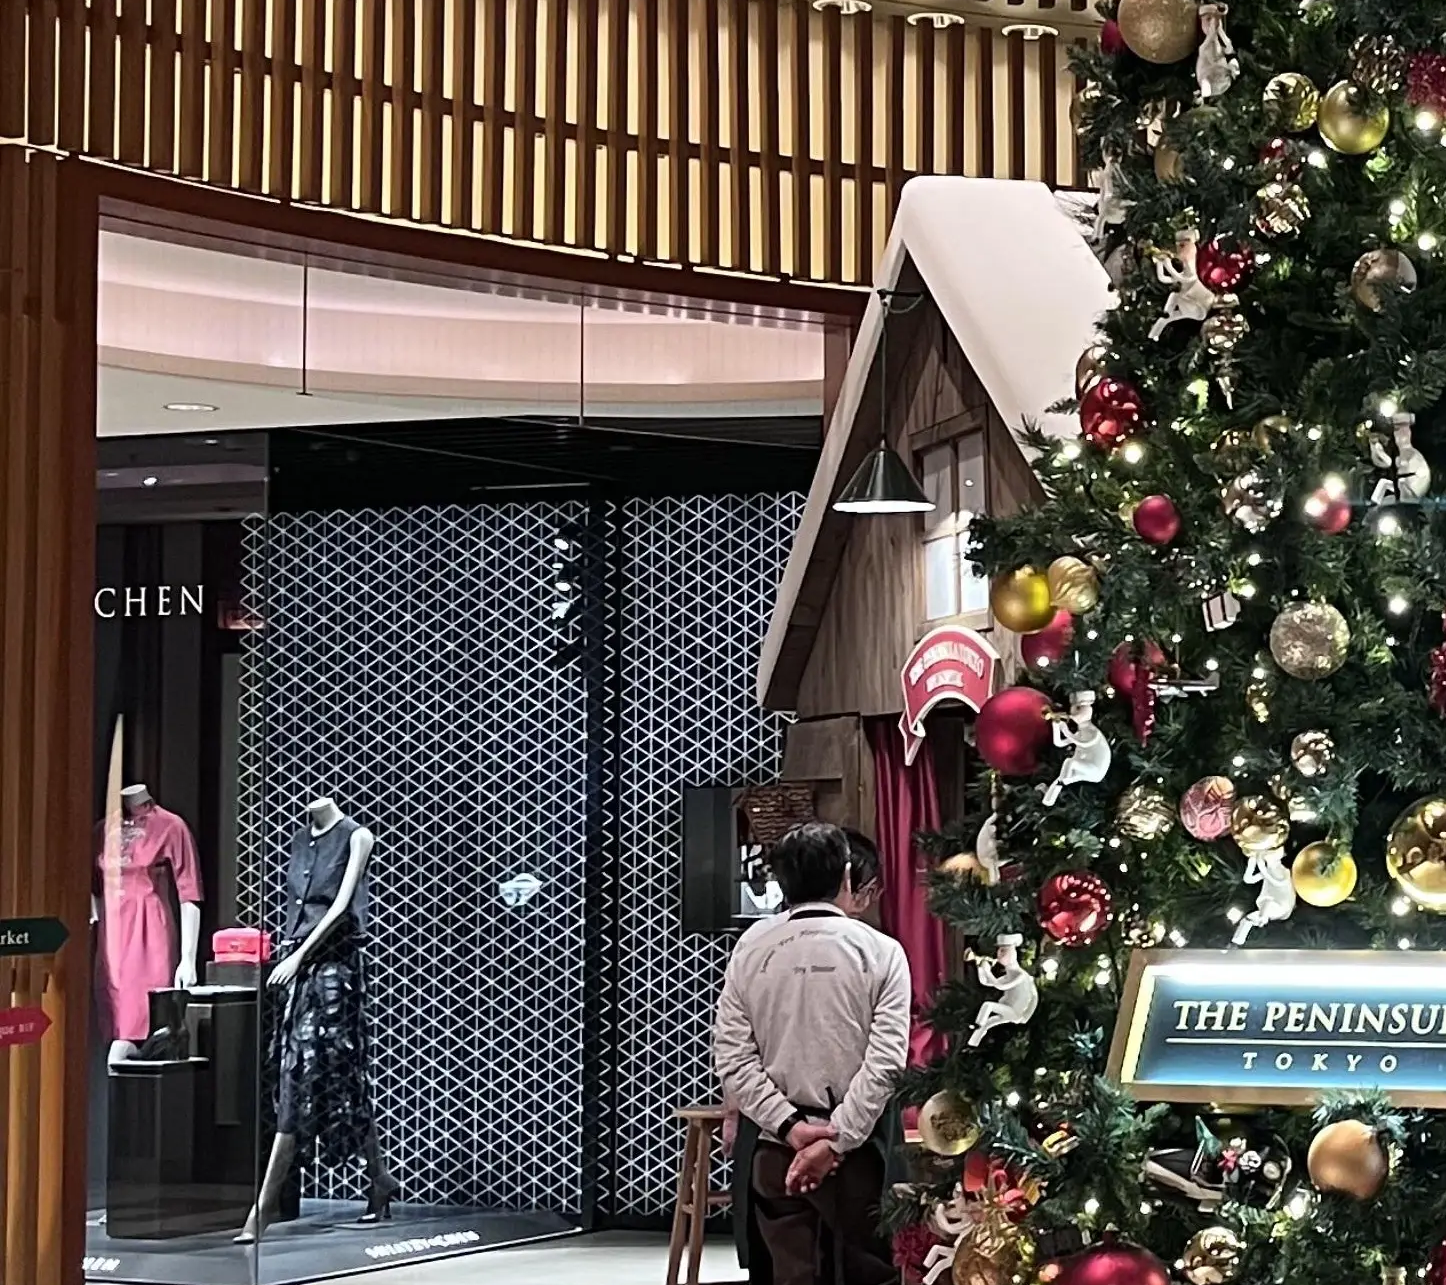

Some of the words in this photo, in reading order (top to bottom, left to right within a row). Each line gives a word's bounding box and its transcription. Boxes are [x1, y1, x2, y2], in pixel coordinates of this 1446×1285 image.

[94, 584, 204, 618] CHEN
[1173, 1000, 1249, 1032] THE
[1242, 1052, 1399, 1074] TOKYO
